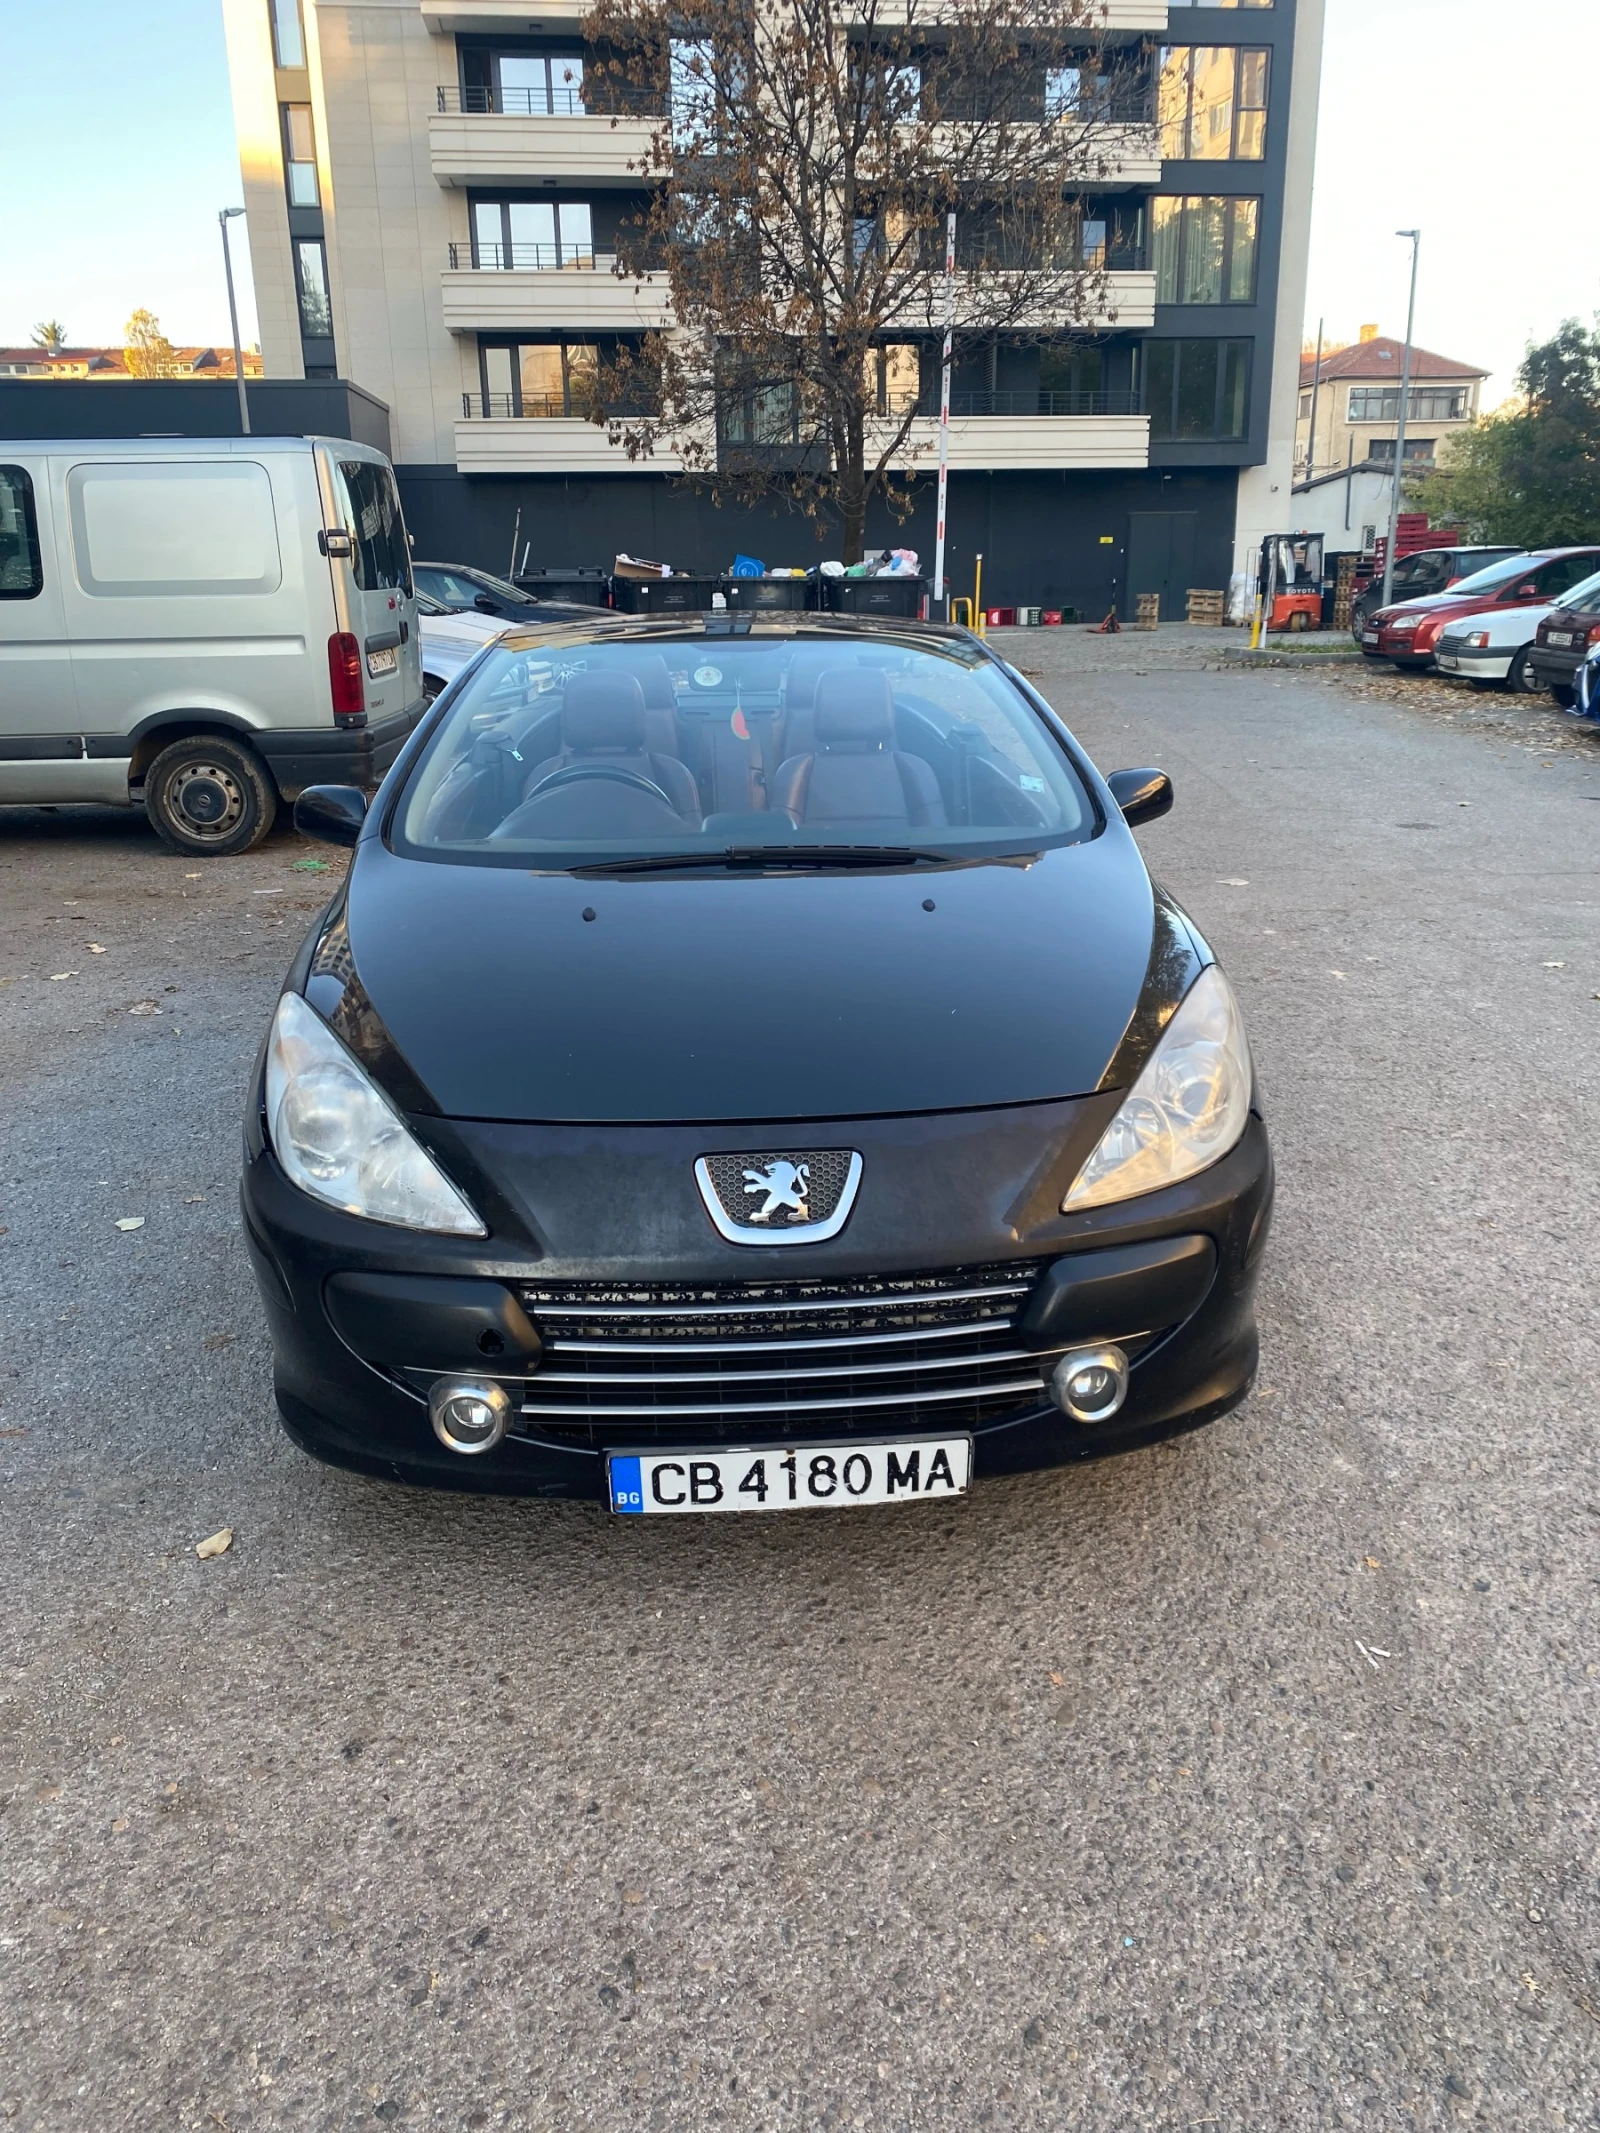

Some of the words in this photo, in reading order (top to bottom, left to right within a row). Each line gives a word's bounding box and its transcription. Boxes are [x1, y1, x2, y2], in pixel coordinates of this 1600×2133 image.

[651, 1461, 725, 1506] CB
[738, 1453, 874, 1503] 4180
[886, 1448, 956, 1495] MA
[616, 1491, 640, 1505] BG
